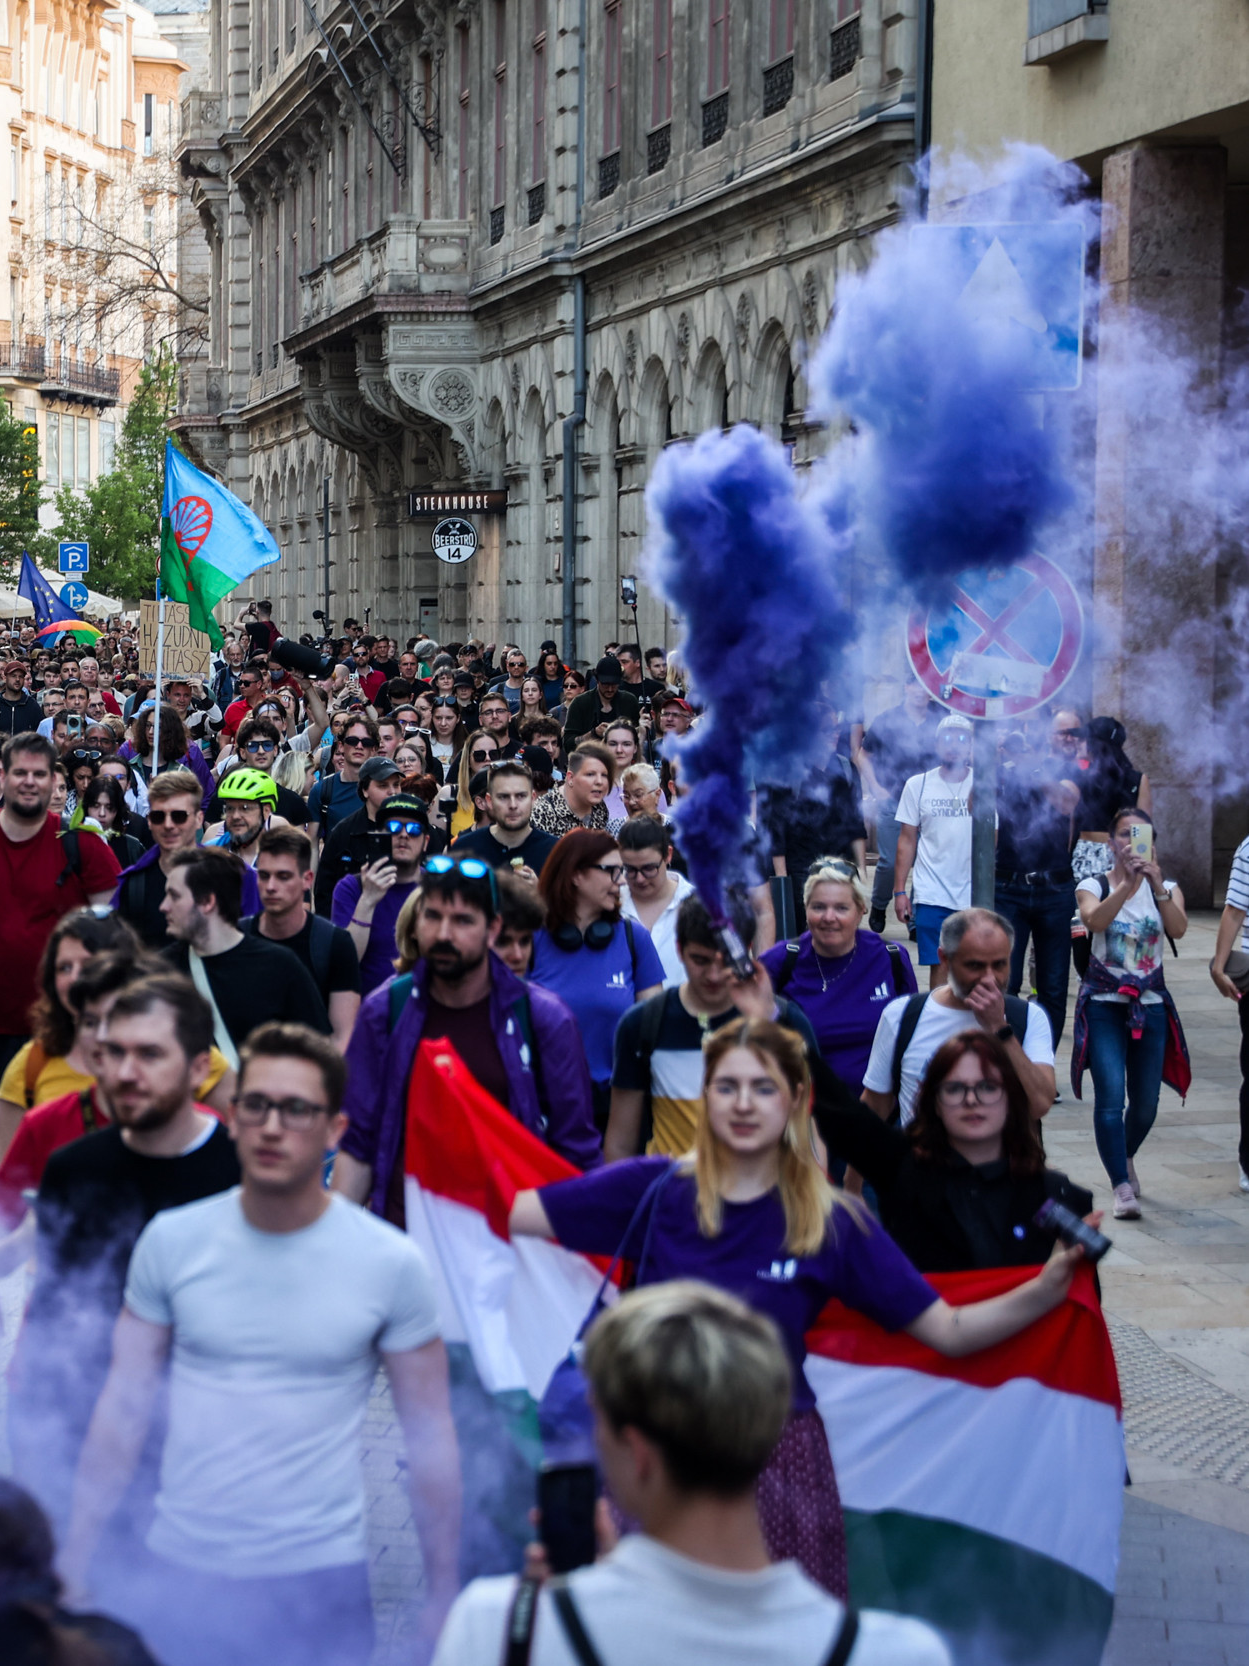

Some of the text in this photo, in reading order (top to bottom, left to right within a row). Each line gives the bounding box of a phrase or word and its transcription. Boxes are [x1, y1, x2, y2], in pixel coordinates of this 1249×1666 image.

[416, 495, 489, 511] STEAKHOUSE
[435, 533, 474, 548] BEERSTRO
[68, 552, 81, 569] P
[448, 547, 462, 560] 14
